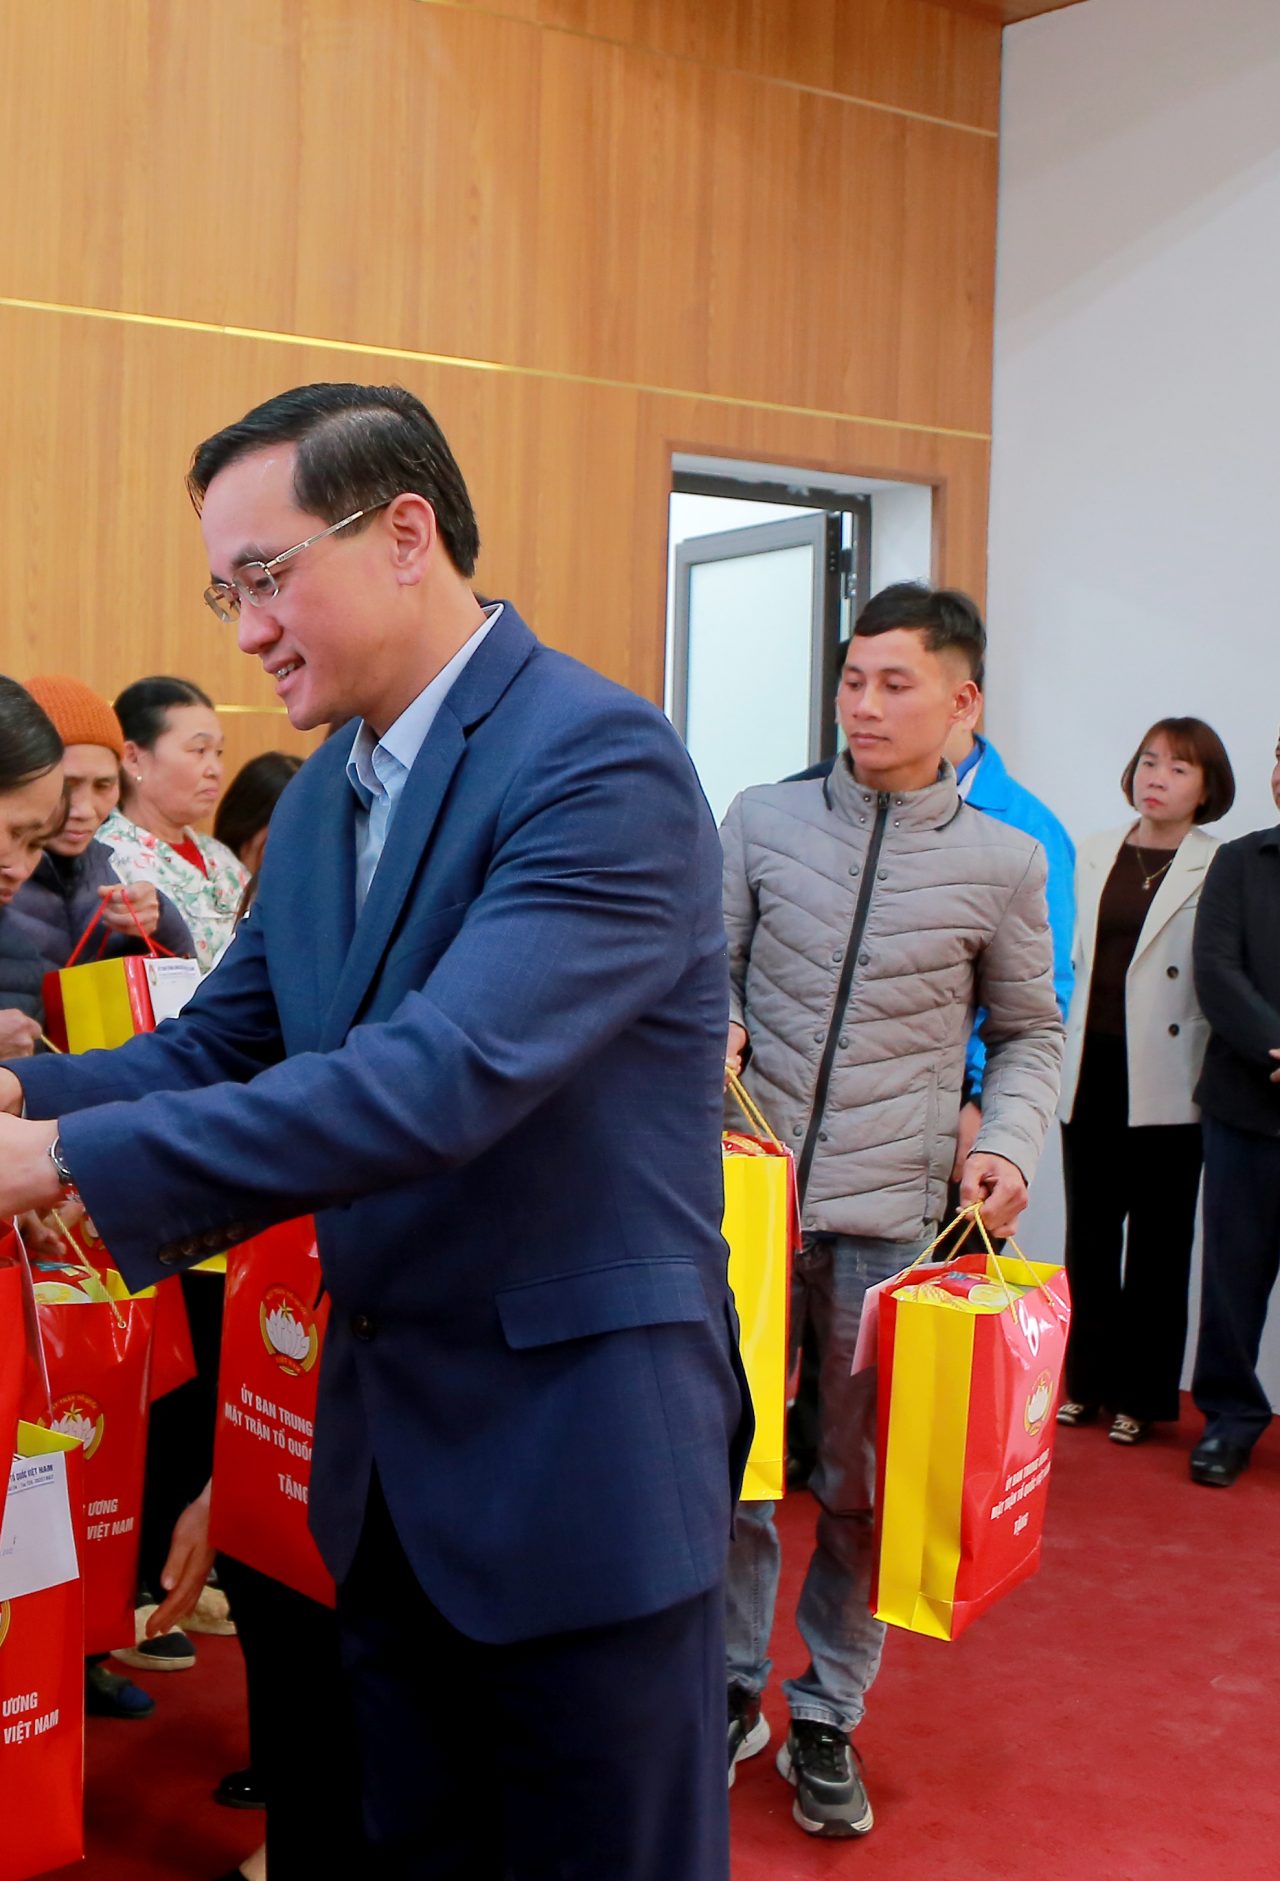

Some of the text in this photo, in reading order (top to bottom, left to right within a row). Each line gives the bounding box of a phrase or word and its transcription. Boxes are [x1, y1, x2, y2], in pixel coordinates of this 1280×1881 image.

[224, 1401, 243, 1427] MẶT
[244, 1415, 271, 1441] TRẬN
[273, 1428, 286, 1449] TỔ
[241, 1383, 314, 1437] ỦY BAN TRUNG
[88, 1499, 119, 1517] ƯƠNG
[87, 1517, 135, 1541] VIỆT NAM
[2, 1691, 38, 1717] ƯƠNG
[3, 1720, 32, 1744] VIỆT
[34, 1708, 59, 1735] NAM
